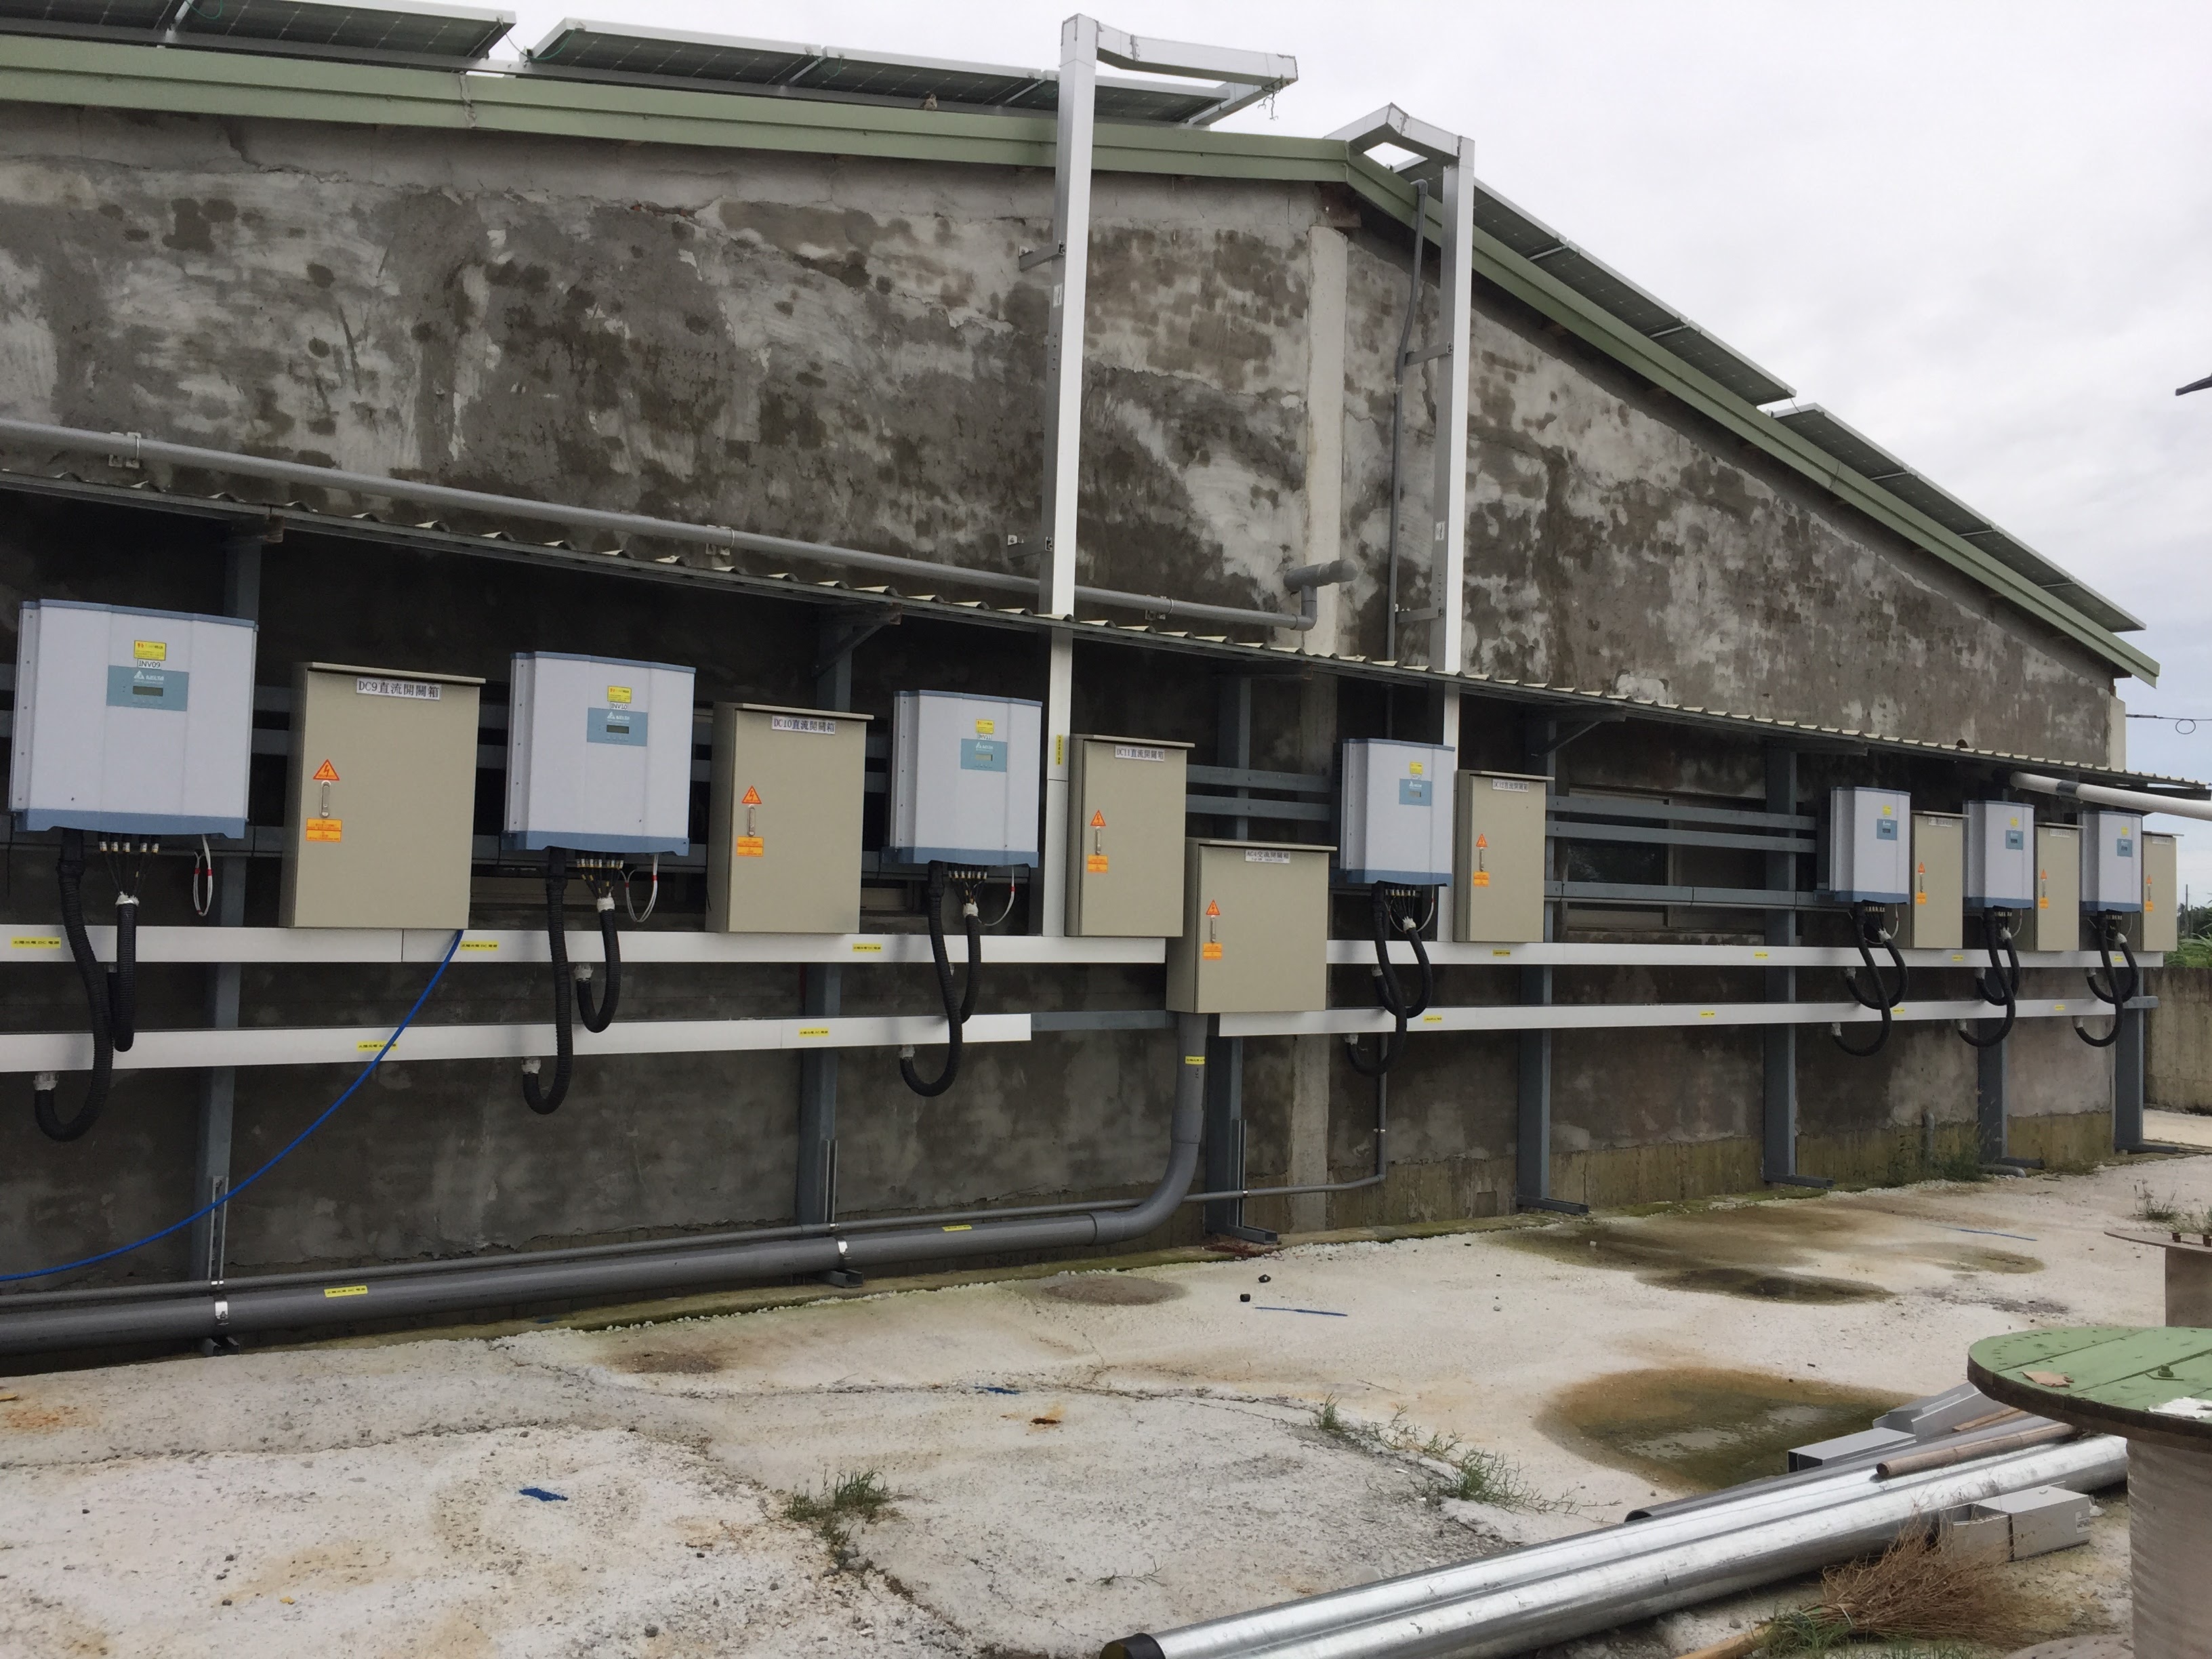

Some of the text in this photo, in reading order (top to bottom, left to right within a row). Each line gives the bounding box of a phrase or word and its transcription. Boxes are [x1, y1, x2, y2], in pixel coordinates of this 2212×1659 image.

[138, 660, 161, 668] INV09
[359, 680, 440, 698] DC9直流開關箱
